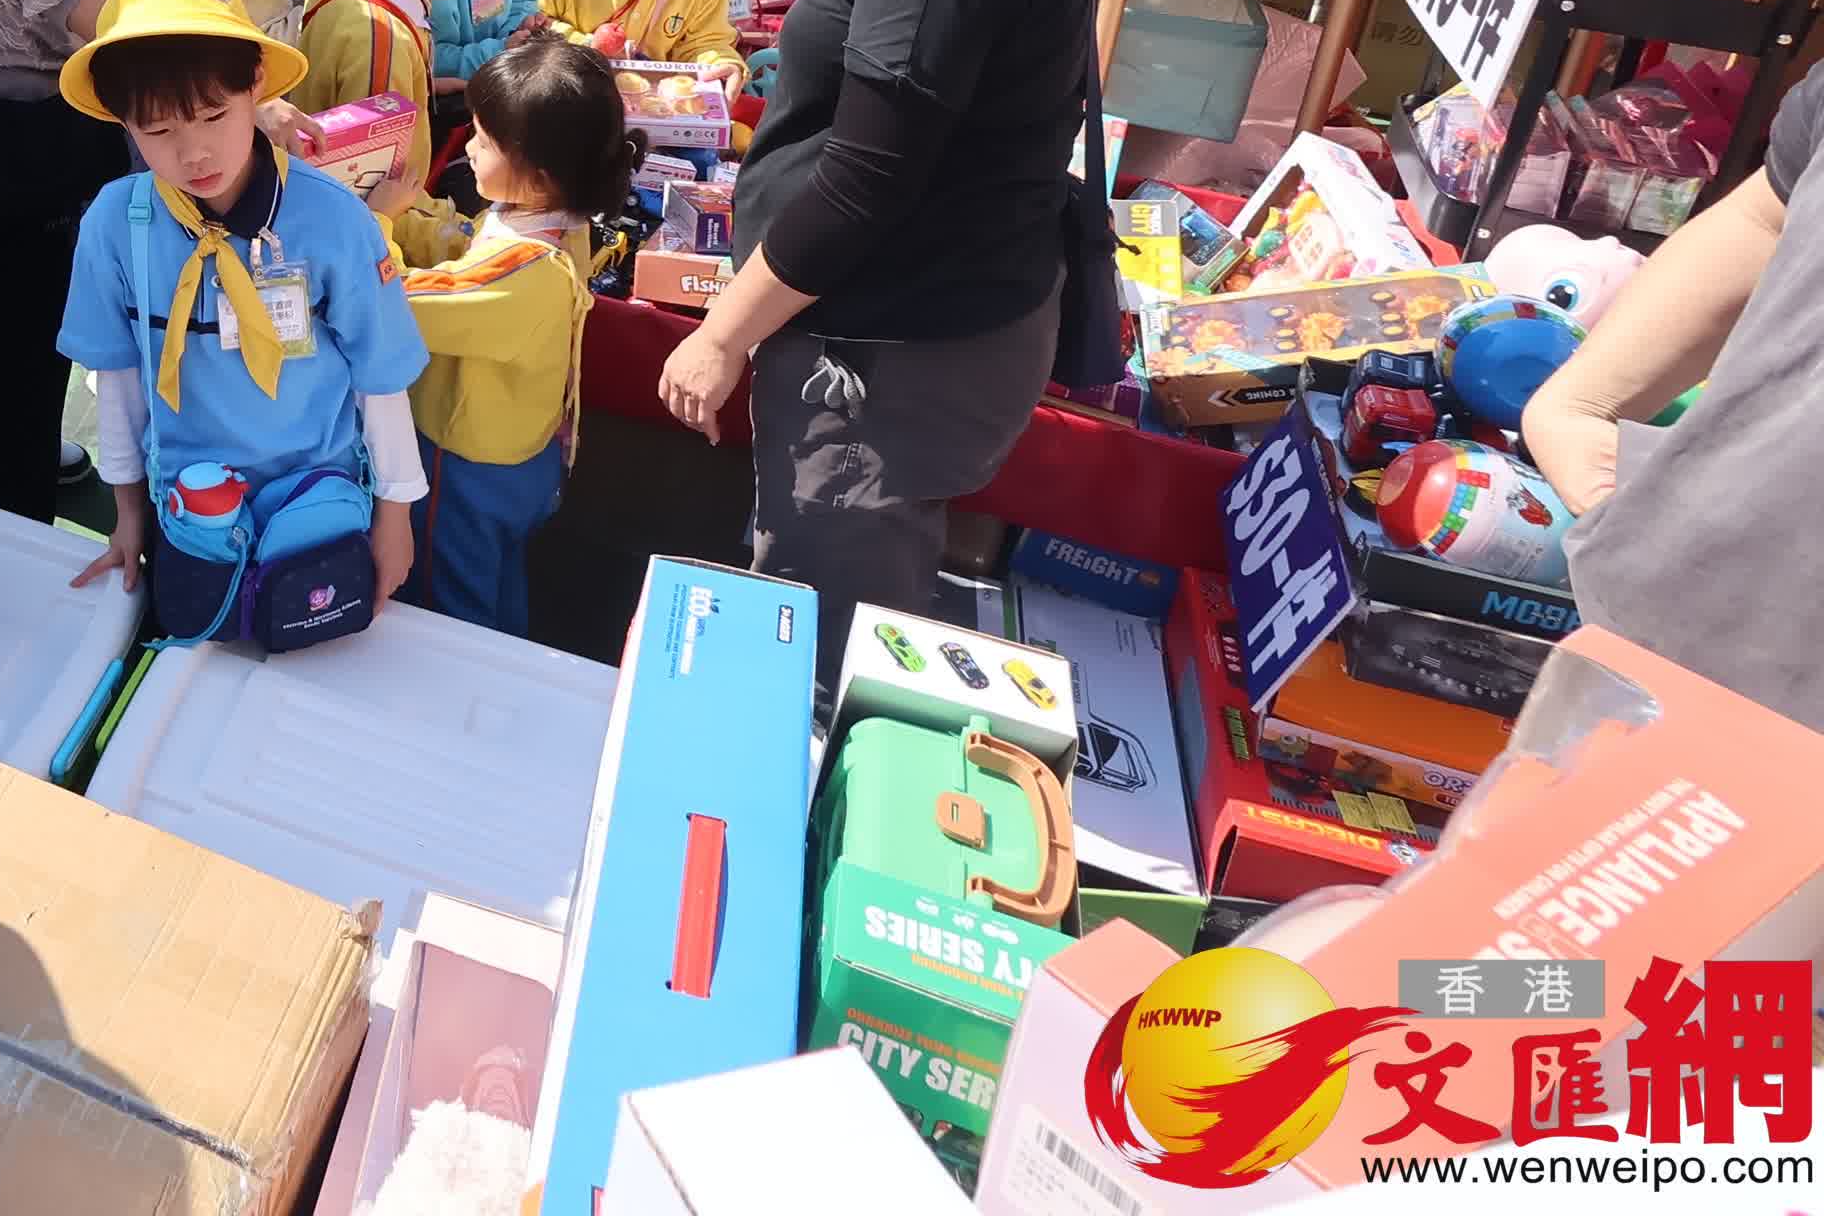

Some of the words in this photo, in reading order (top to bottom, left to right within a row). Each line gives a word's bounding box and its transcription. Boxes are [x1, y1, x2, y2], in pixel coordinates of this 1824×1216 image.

[1128, 202, 1145, 235] CITY
[1245, 387, 1288, 400] COMING
[688, 585, 713, 617] ECO
[1246, 805, 1382, 852] DIECAST
[1535, 789, 1745, 945] APPLIANCE
[864, 905, 986, 974] SERIES
[837, 1022, 923, 1079] CITY
